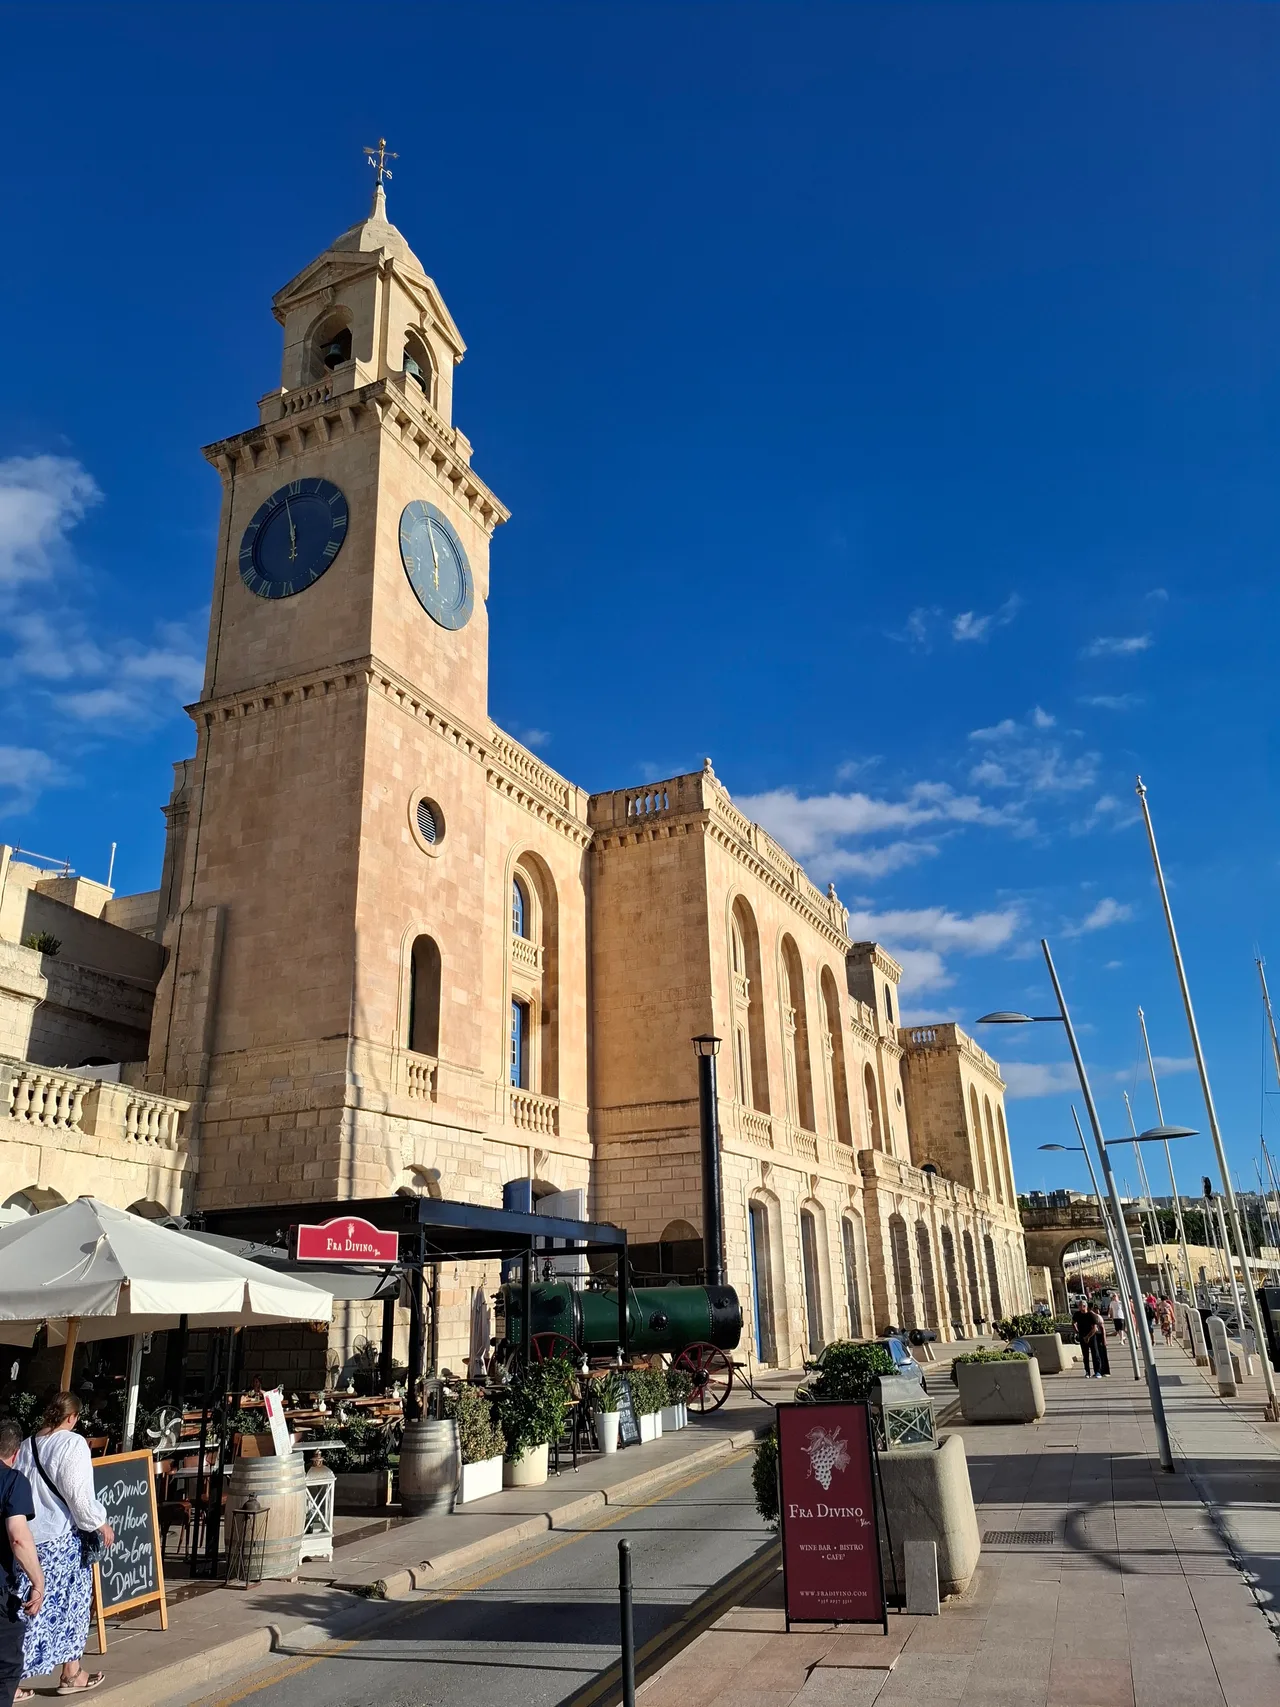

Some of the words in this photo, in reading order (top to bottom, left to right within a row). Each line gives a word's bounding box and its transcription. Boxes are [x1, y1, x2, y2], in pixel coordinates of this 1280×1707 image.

[326, 1238, 342, 1251] FRA
[345, 1239, 374, 1252] DIVINO
[96, 1485, 116, 1506] FRA
[113, 1480, 148, 1505] DIVINO
[788, 1504, 813, 1518] FRA
[816, 1503, 863, 1518] DIVINO
[106, 1514, 124, 1535] PPY
[110, 1555, 153, 1602] DAILY!
